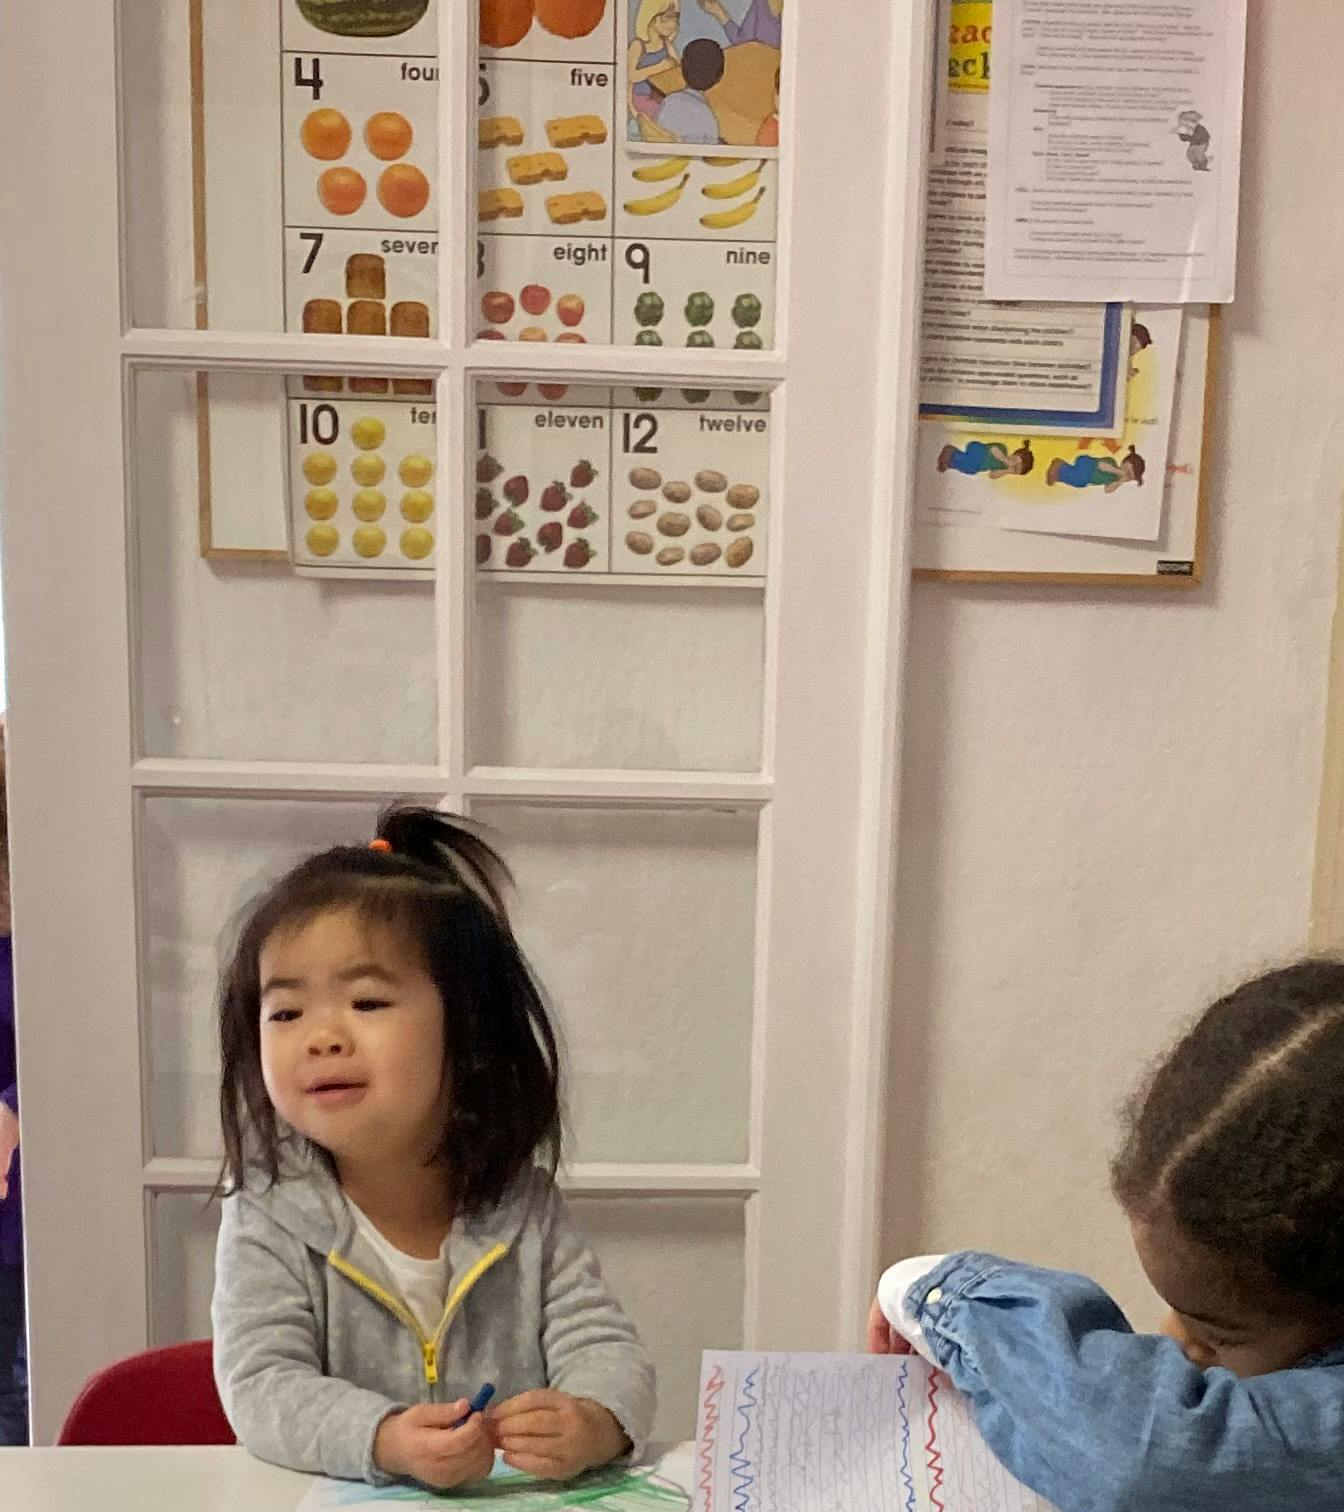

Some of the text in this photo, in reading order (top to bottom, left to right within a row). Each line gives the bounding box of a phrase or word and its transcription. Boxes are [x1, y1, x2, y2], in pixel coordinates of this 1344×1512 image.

[294, 57, 324, 101] 4
[570, 68, 609, 88] five
[300, 232, 324, 274] 7
[553, 241, 608, 266] eight
[625, 243, 771, 284] 9 nine
[300, 404, 339, 446] 10
[535, 410, 604, 430] eleven
[622, 412, 767, 454] 12 twelve
